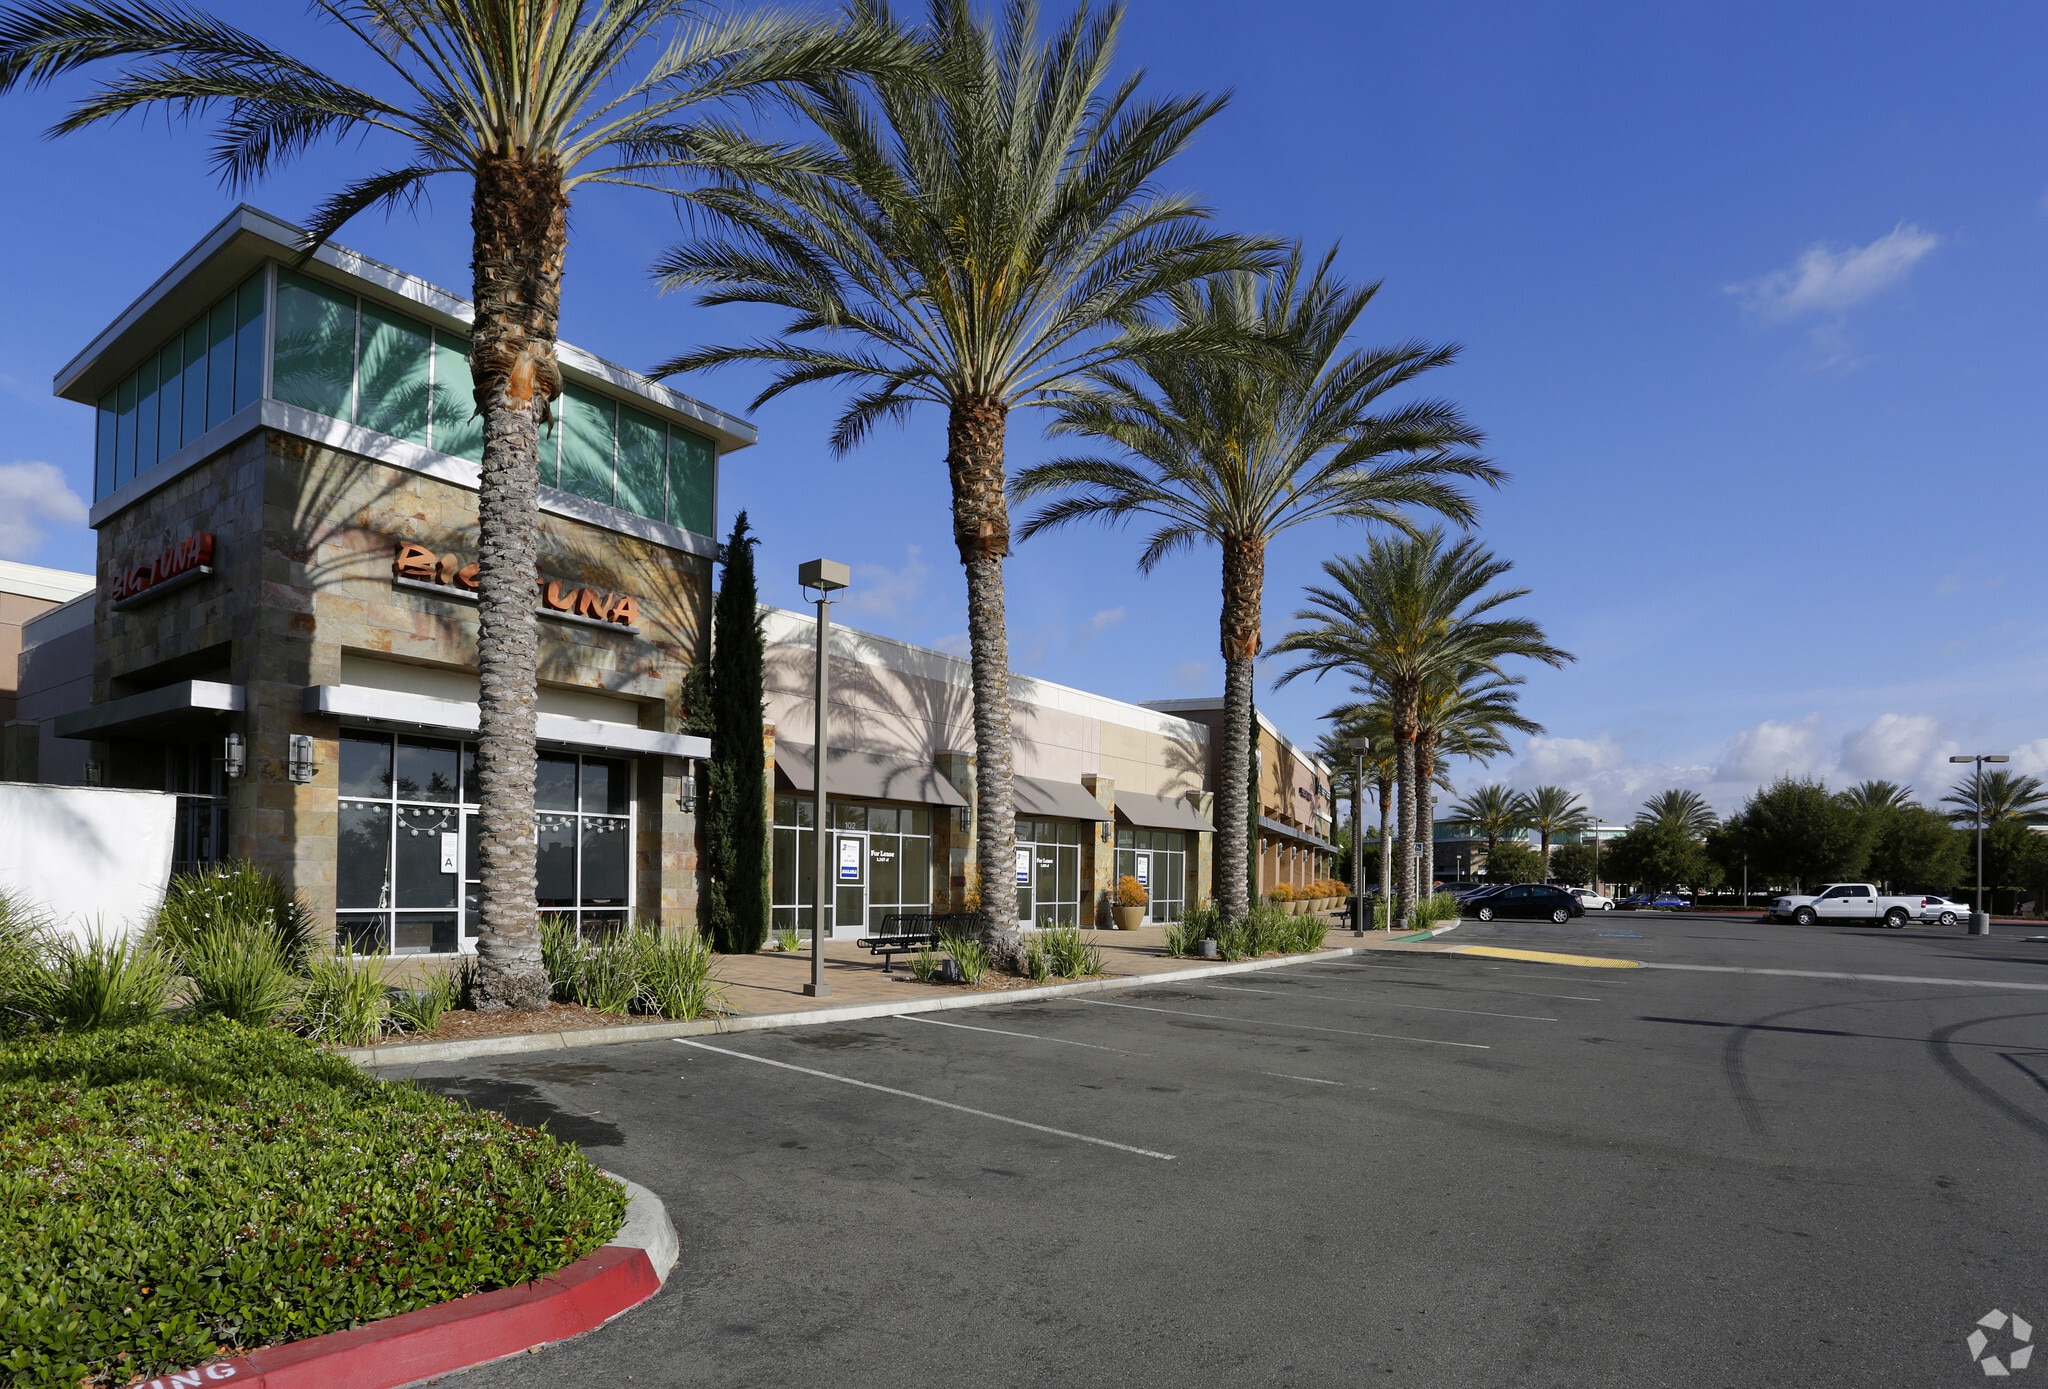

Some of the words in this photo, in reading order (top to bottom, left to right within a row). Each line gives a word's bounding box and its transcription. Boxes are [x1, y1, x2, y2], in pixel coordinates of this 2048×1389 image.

[110, 562, 143, 600] BIG
[143, 533, 212, 587] TUNA
[536, 577, 641, 626] UNA
[845, 821, 856, 829] 102
[444, 857, 453, 867] A
[870, 849, 880, 857] For
[880, 850, 895, 858] Lease
[133, 1363, 236, 1389] ING
